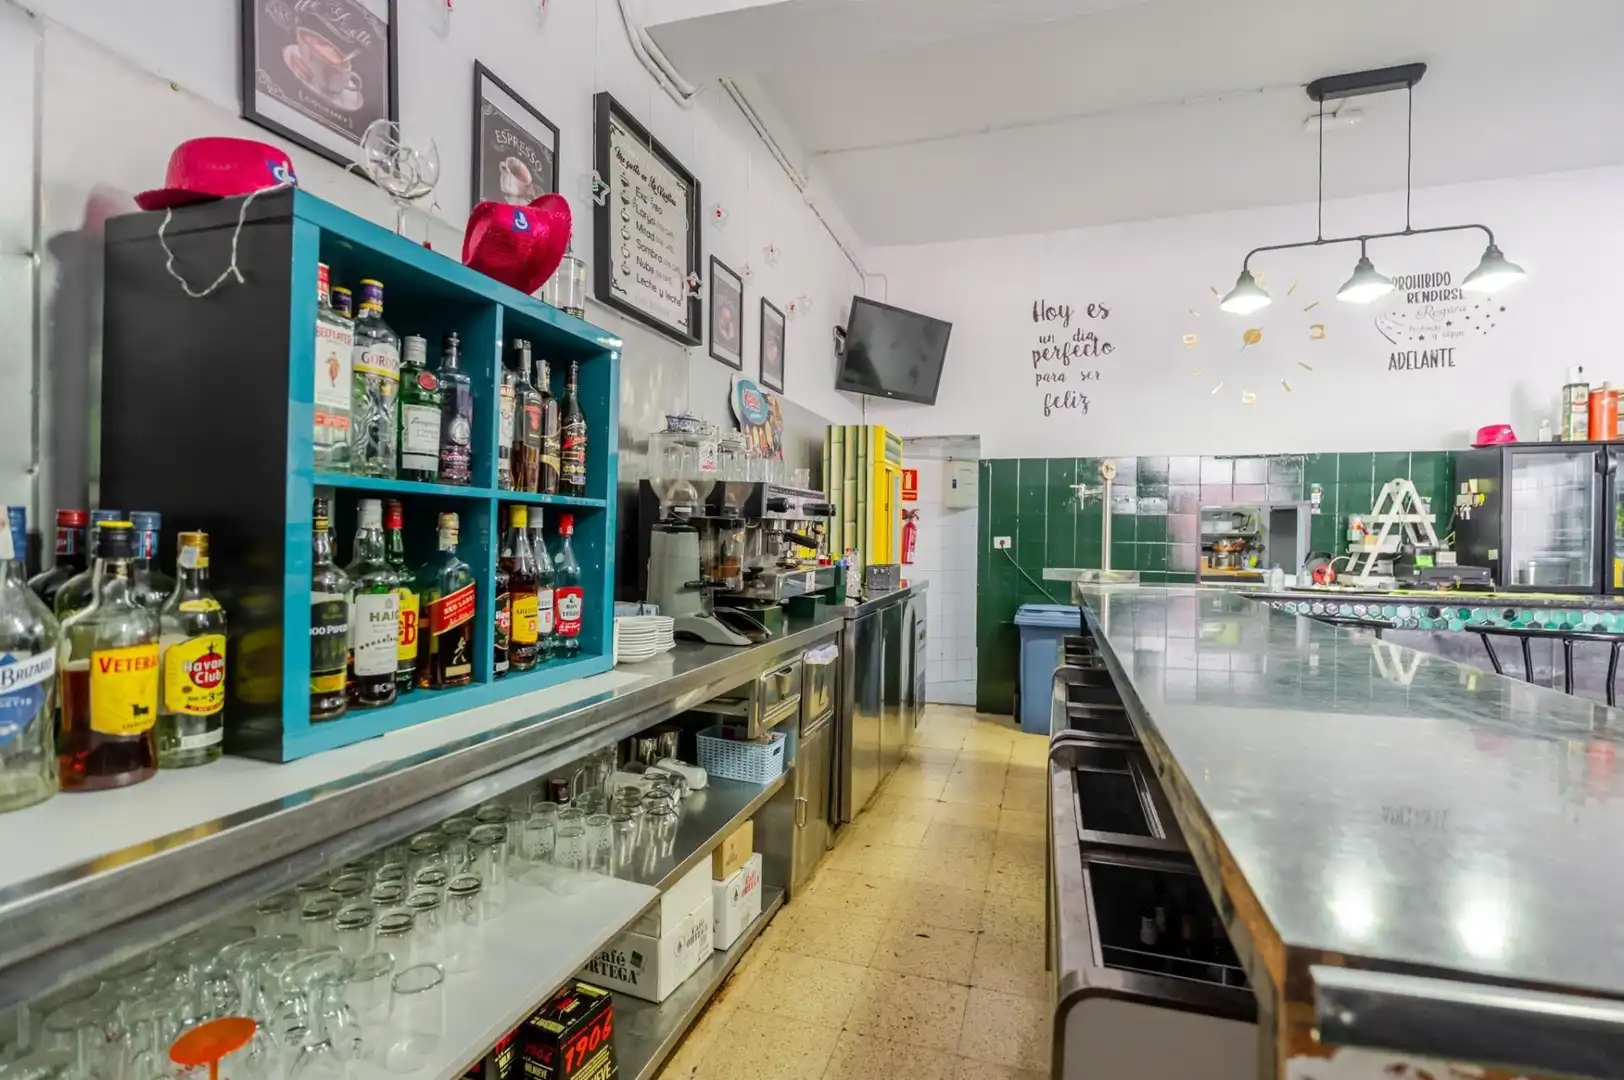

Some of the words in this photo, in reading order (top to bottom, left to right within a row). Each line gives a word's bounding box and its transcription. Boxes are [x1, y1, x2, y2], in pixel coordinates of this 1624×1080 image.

[495, 129, 542, 172] ESPRESSO
[636, 239, 662, 263] Sombra
[1033, 299, 1075, 328] Hoy
[1087, 302, 1111, 320] es
[1032, 336, 1116, 369] perfecto
[1388, 348, 1456, 371] ADELANTE
[1036, 372, 1068, 387] para
[1080, 371, 1101, 381] ser
[1044, 390, 1090, 417] feliz
[1, 656, 54, 686] BRIZARD
[195, 672, 222, 684] Club
[565, 1008, 613, 1074] 1906
